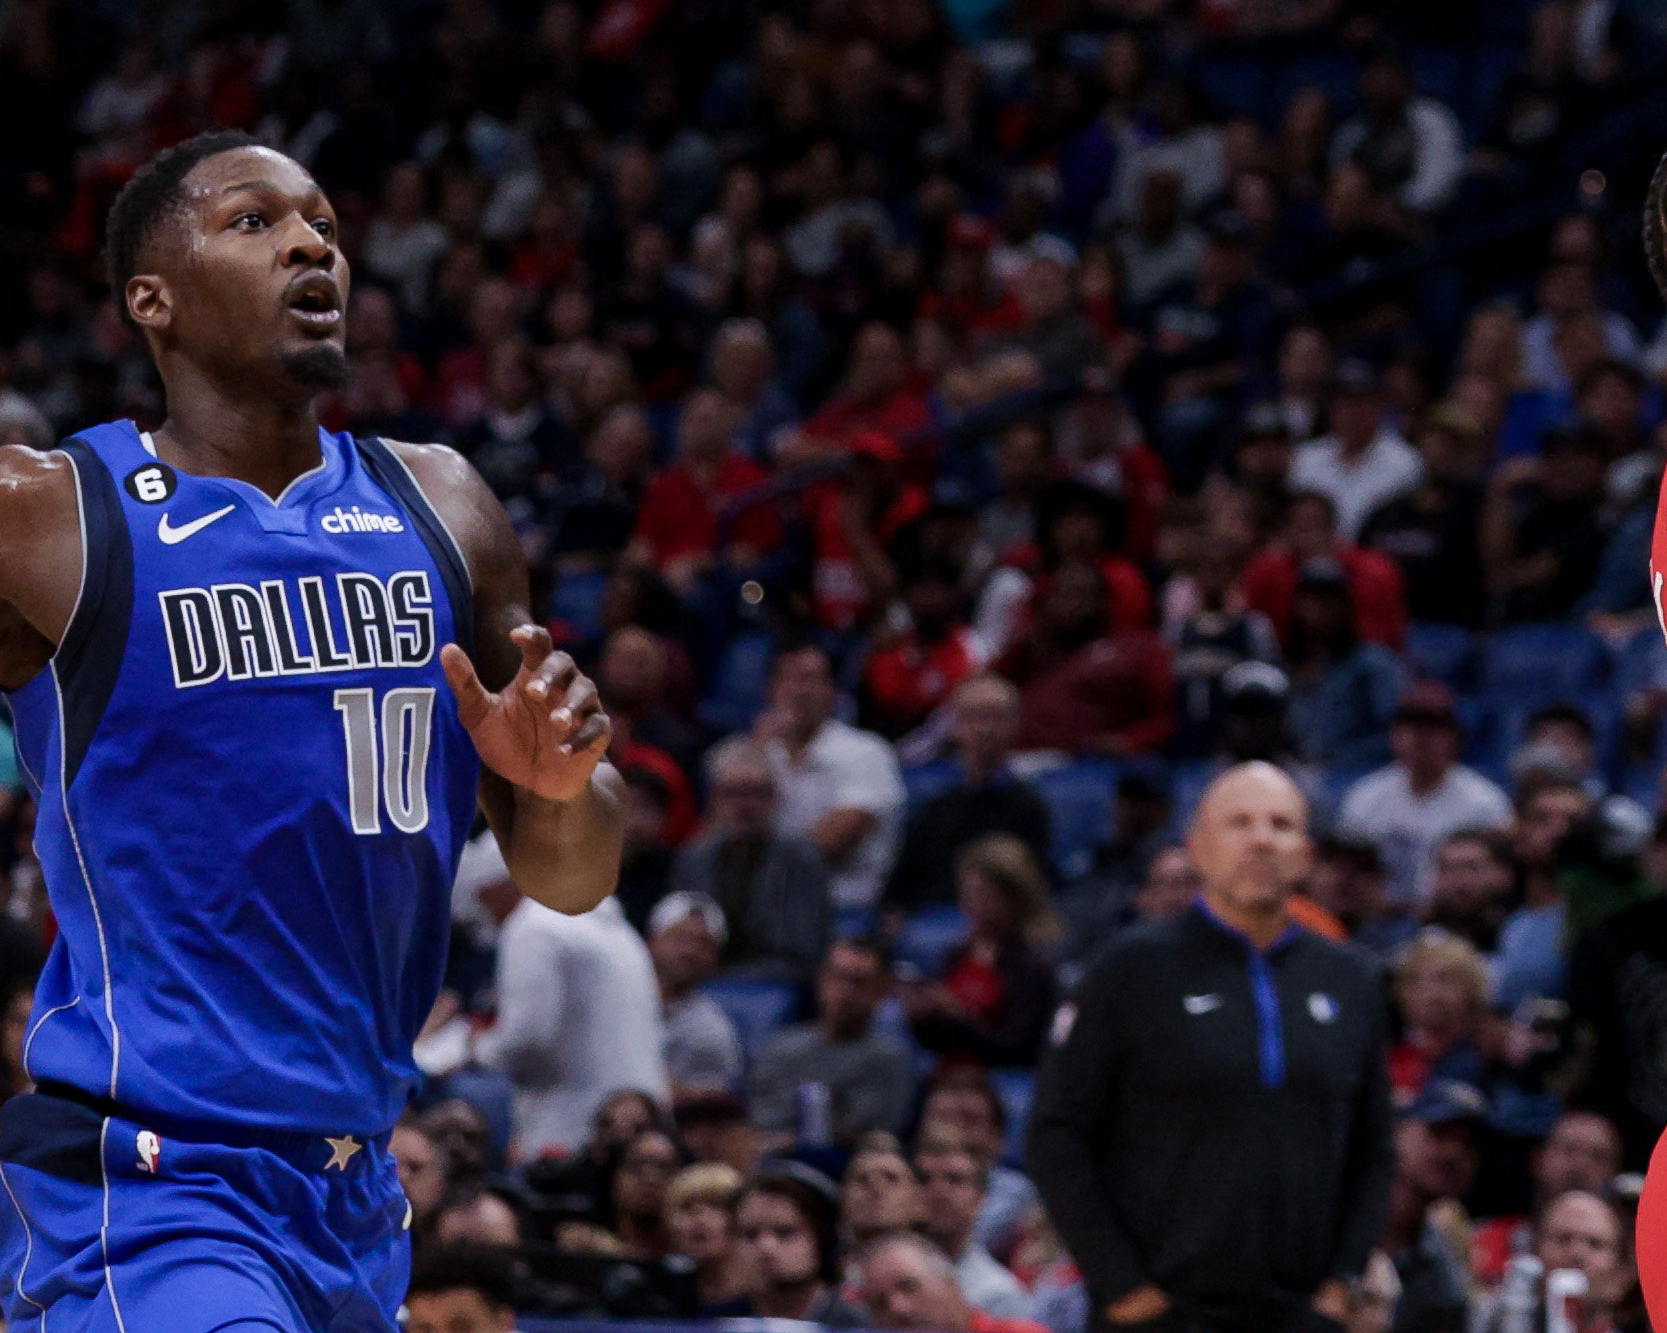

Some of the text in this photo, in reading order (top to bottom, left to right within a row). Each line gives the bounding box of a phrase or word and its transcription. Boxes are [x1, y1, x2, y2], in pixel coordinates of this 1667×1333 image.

[134, 468, 168, 502] 6
[320, 505, 405, 535] chime
[158, 569, 437, 689] DALLAS
[333, 685, 437, 836] 10
